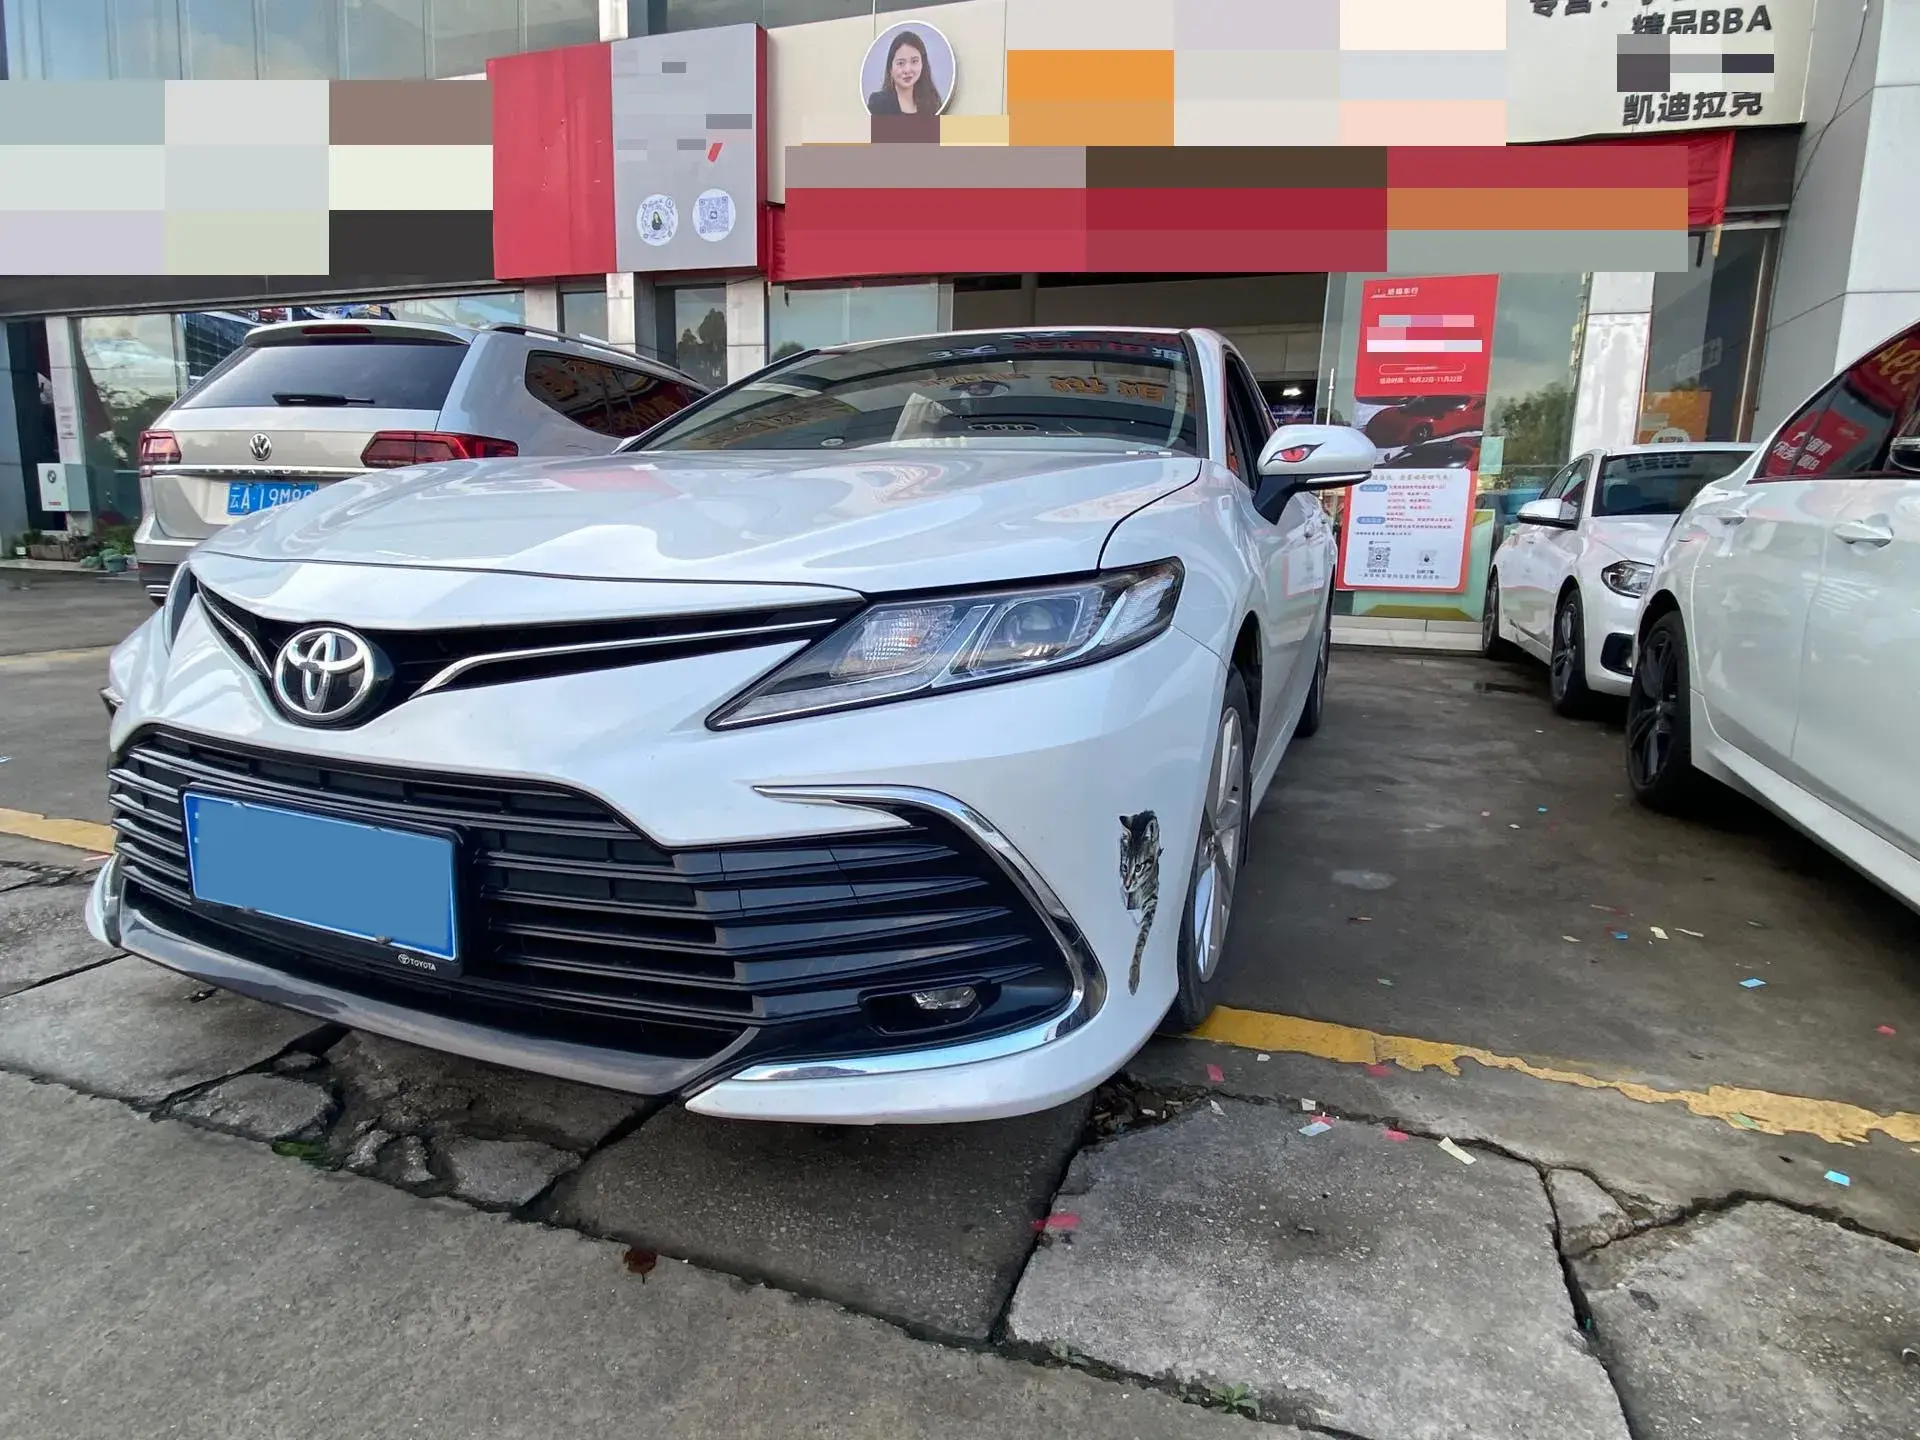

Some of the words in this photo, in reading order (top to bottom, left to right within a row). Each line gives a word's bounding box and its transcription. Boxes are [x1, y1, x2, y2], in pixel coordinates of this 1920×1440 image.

[1622, 92, 1763, 126] 凯迪拉克
[411, 958, 436, 971] TOYOTA
